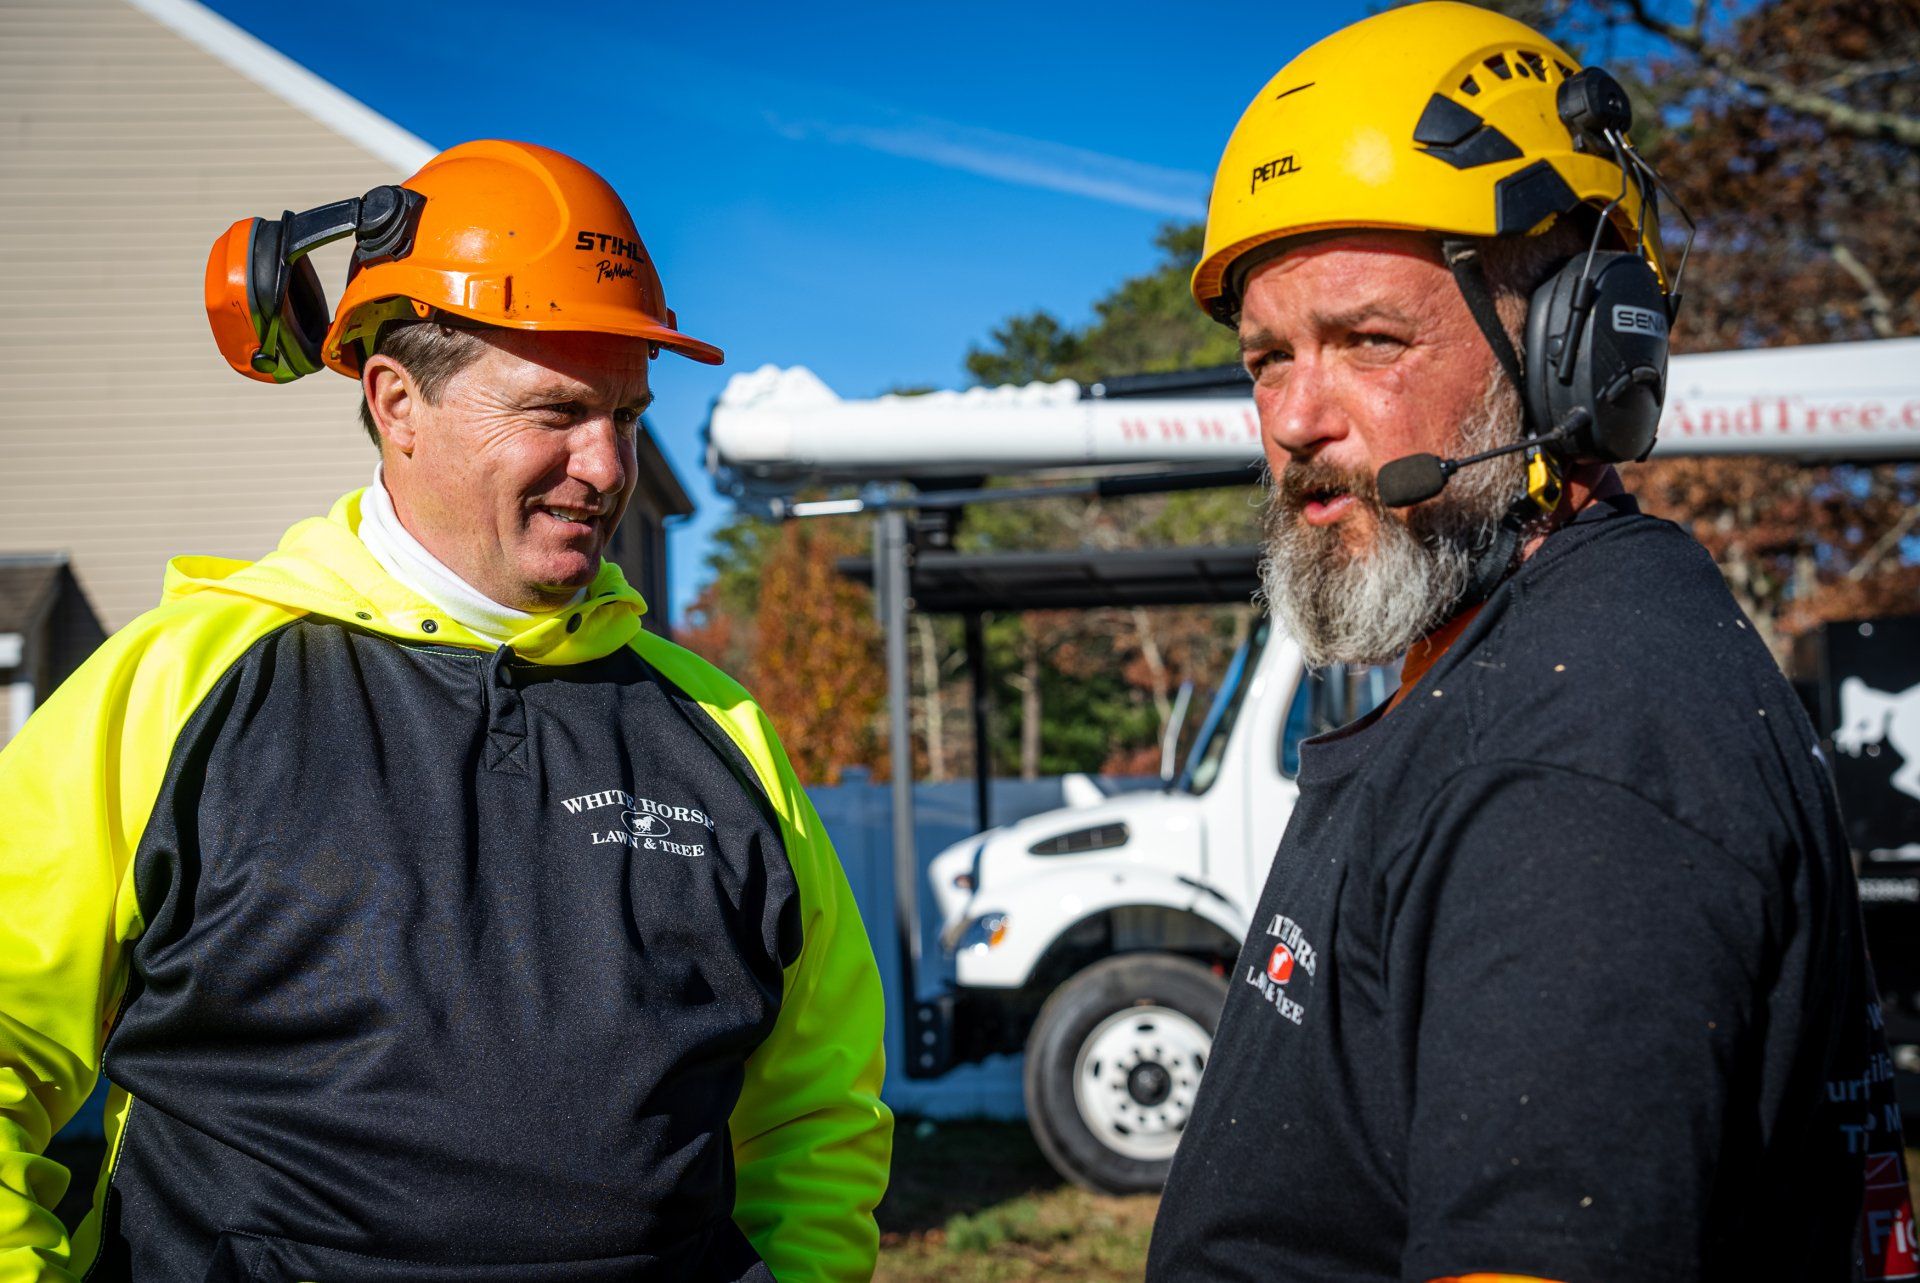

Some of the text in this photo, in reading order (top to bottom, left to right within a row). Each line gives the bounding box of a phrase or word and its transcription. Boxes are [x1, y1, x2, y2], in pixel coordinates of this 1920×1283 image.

[1250, 155, 1302, 195] PETZL
[575, 231, 644, 264] STIHL
[561, 790, 715, 832] WHITE HORSE
[591, 830, 705, 857] LAWN & TREE
